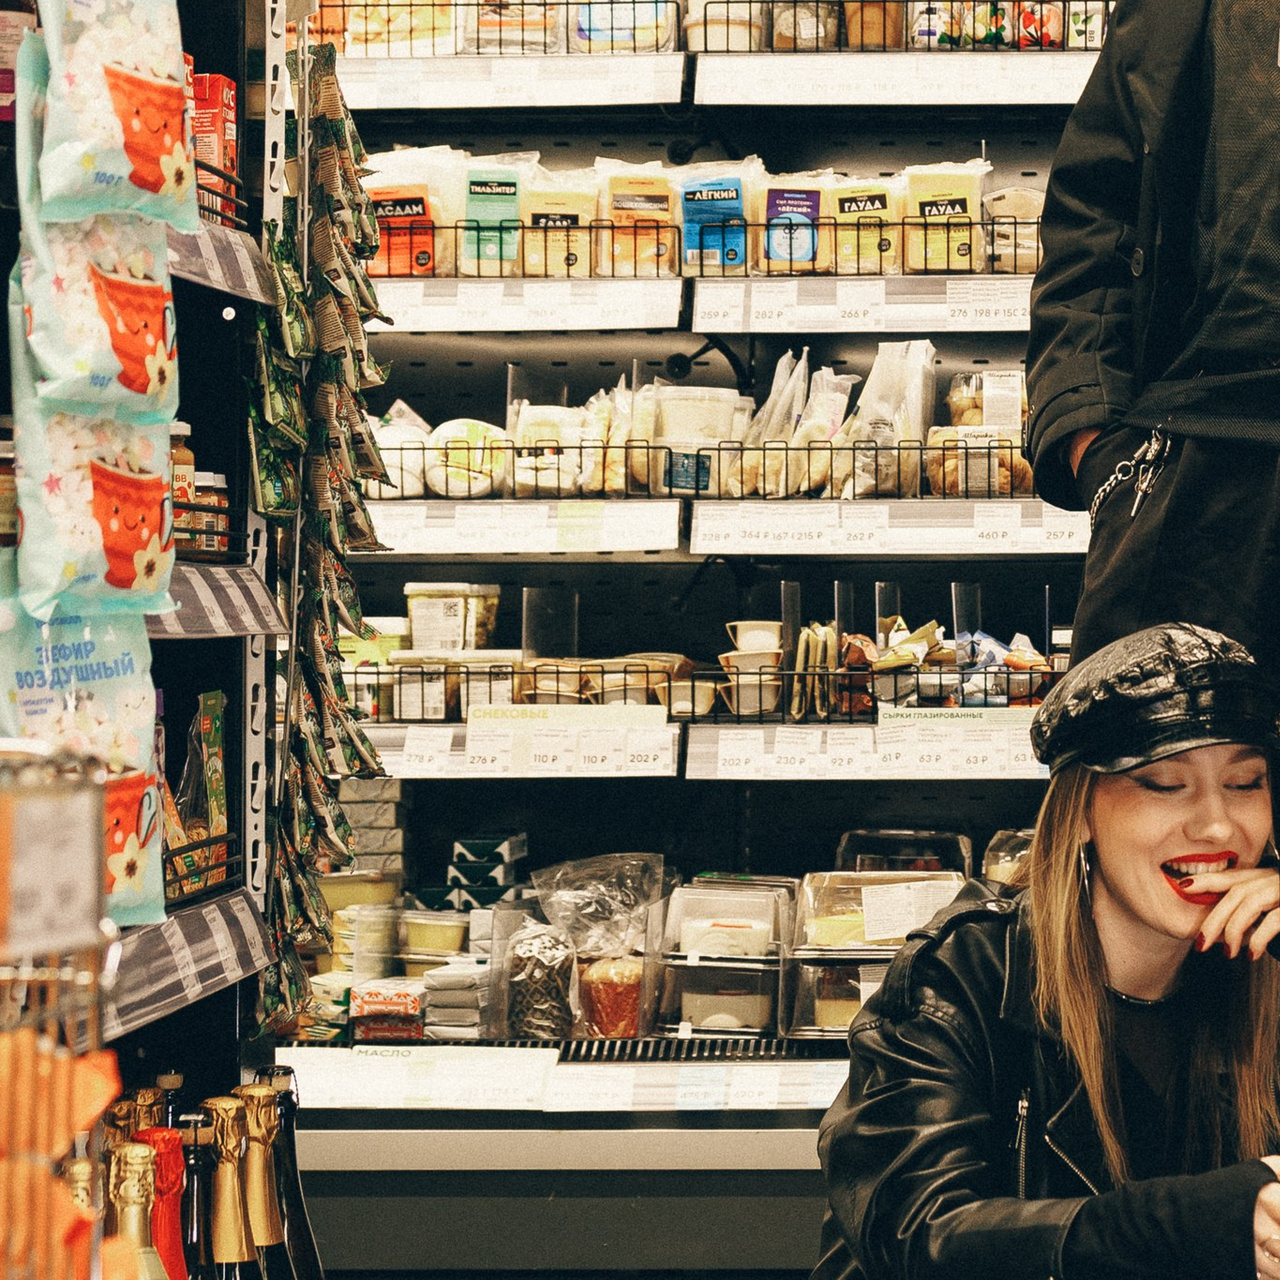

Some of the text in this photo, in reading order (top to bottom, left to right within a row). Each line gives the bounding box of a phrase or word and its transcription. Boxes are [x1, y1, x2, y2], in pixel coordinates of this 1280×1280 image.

[694, 188, 737, 201] ЛЁГКИЙ
[843, 199, 883, 212] ГАУДА
[925, 204, 963, 217] ГАУДА
[700, 311, 719, 319] 259
[755, 310, 774, 318] 282
[841, 310, 859, 318] 266
[951, 308, 968, 317] 276
[974, 308, 990, 317] 198
[702, 533, 720, 541] 228
[741, 531, 760, 539] 364
[773, 532, 788, 540] 167
[797, 532, 813, 540] 215
[846, 533, 864, 541] 262
[978, 531, 998, 539] 460
[1046, 531, 1065, 539] 257
[35, 641, 96, 667] ЗЕФИР
[16, 651, 135, 690] ВОЗДУШНЫЙ
[471, 708, 548, 719] СНЕКОВЫЕ
[882, 711, 984, 720] СЫРКИ ГЛАЗИРОВАННЫЕ
[469, 755, 487, 764] 276
[533, 754, 548, 763] 110
[582, 755, 597, 764] 110
[630, 754, 649, 763] 202
[721, 758, 742, 767] 202
[776, 757, 796, 765] 230
[830, 758, 844, 767] 92
[882, 754, 892, 763] 61
[919, 755, 931, 763] 63
[965, 756, 978, 765] 63
[1014, 754, 1027, 763] 63
[357, 1049, 412, 1058] МАСЛО
